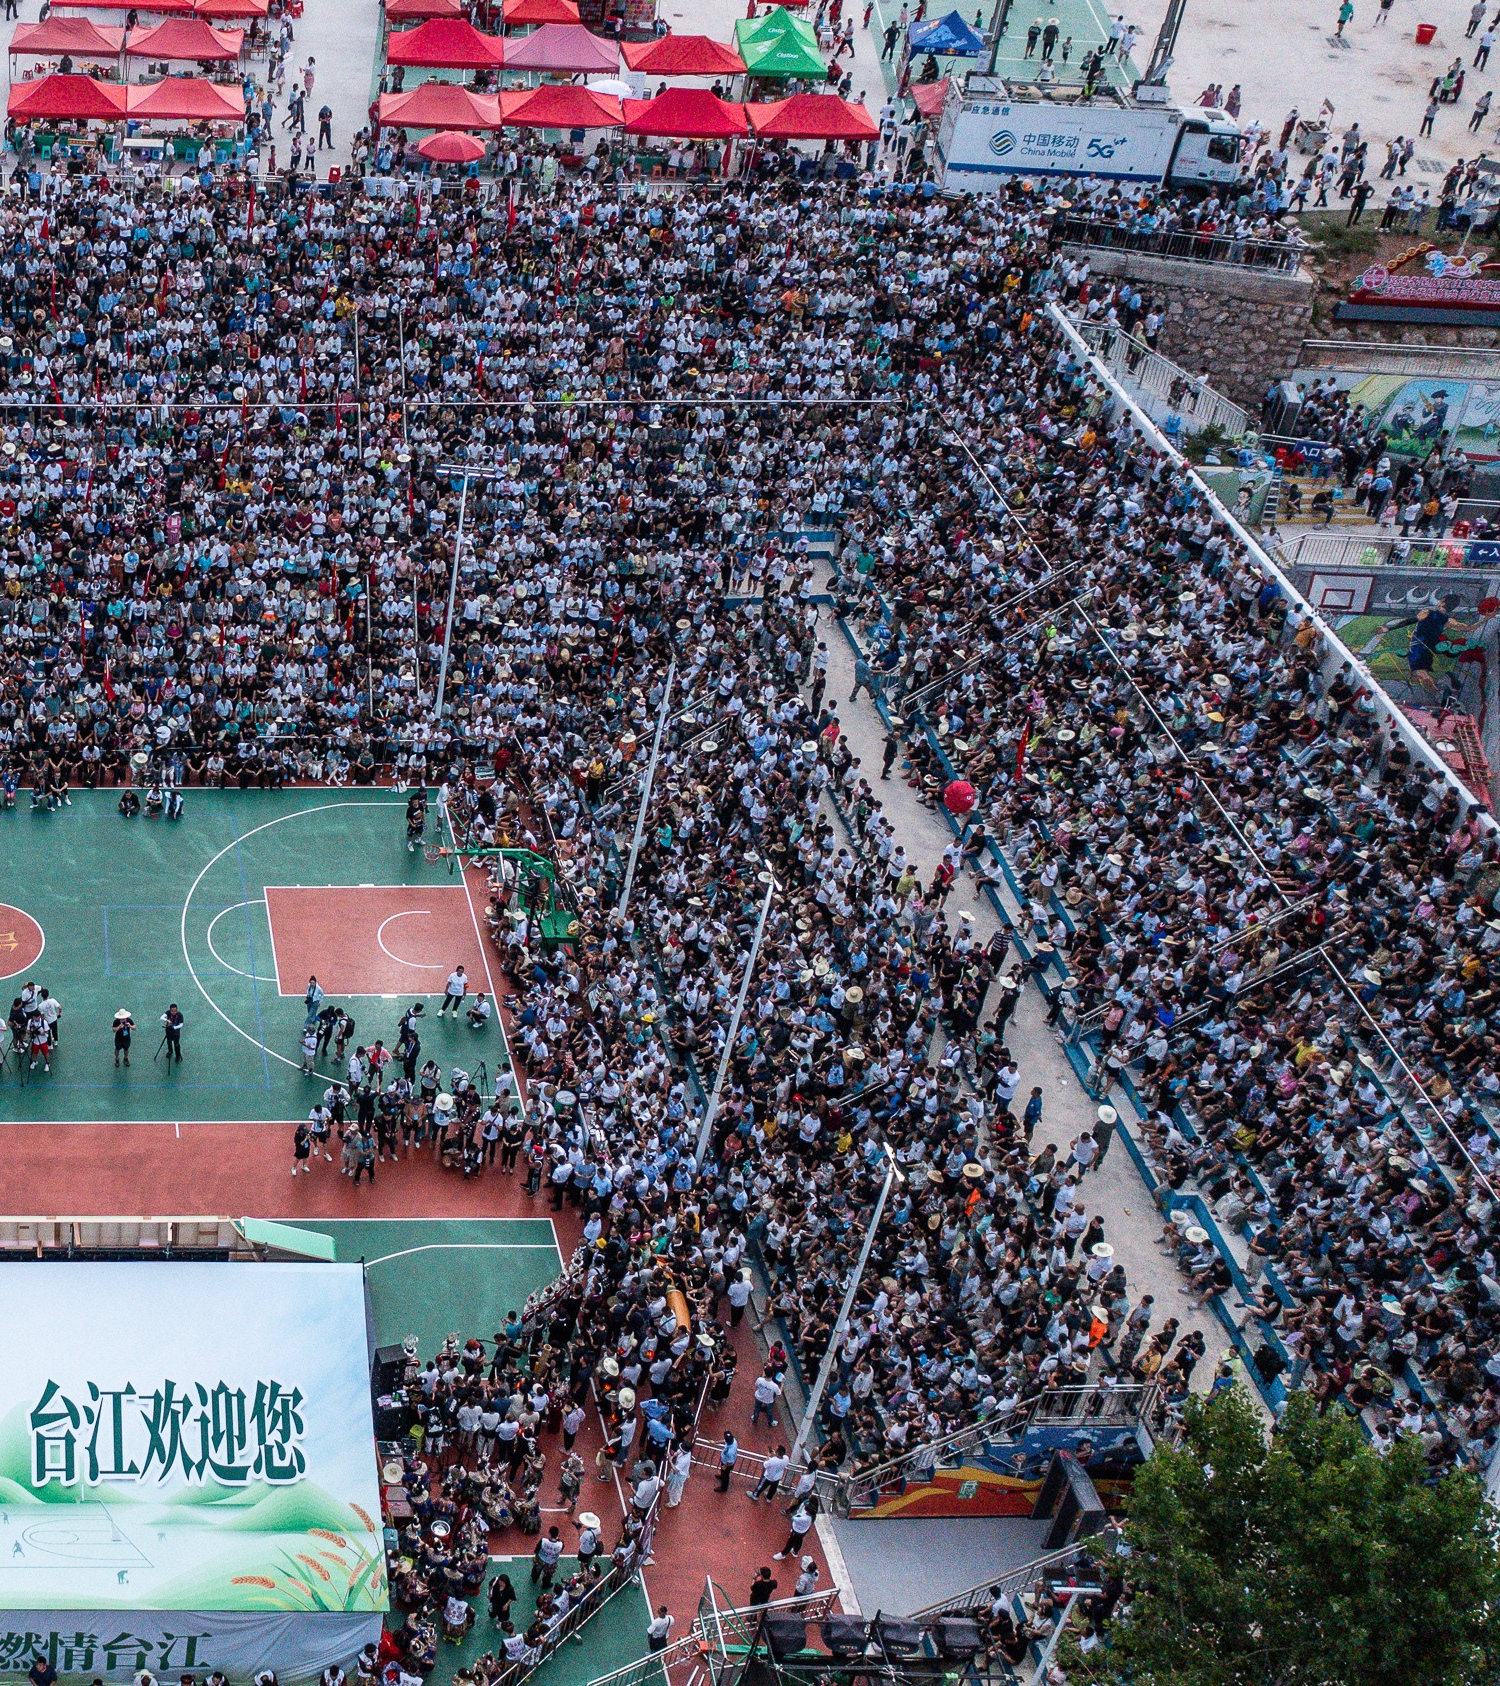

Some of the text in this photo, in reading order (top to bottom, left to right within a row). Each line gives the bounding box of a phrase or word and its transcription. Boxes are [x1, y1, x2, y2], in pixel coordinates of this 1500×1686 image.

[971, 105, 1011, 116] 应急通信
[1023, 133, 1080, 148] 中国移动
[1020, 147, 1077, 159] China Mobile
[1299, 446, 1320, 457] 入口
[30, 1379, 306, 1484] 台江欢迎您
